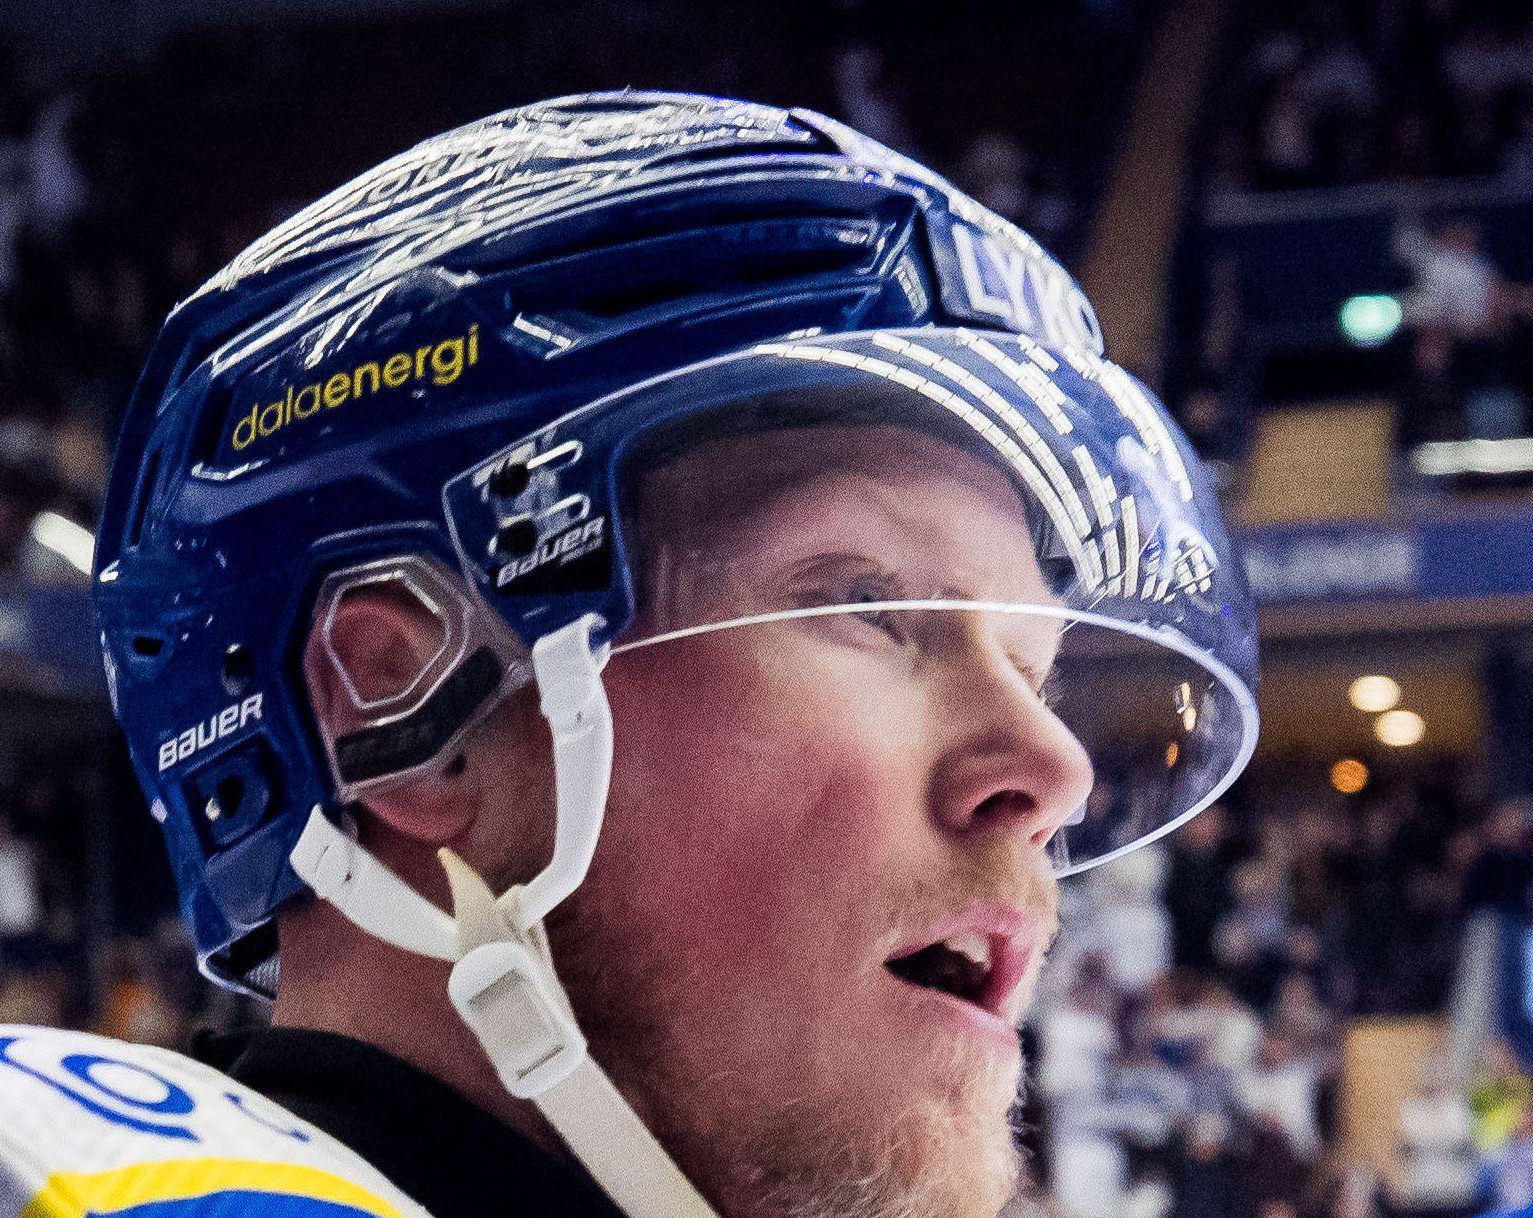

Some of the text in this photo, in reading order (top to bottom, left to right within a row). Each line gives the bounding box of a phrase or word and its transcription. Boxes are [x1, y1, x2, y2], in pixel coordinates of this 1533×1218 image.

[232, 323, 479, 450] dalaenergi
[496, 516, 605, 578] BAUER
[158, 692, 263, 773] BAUER
